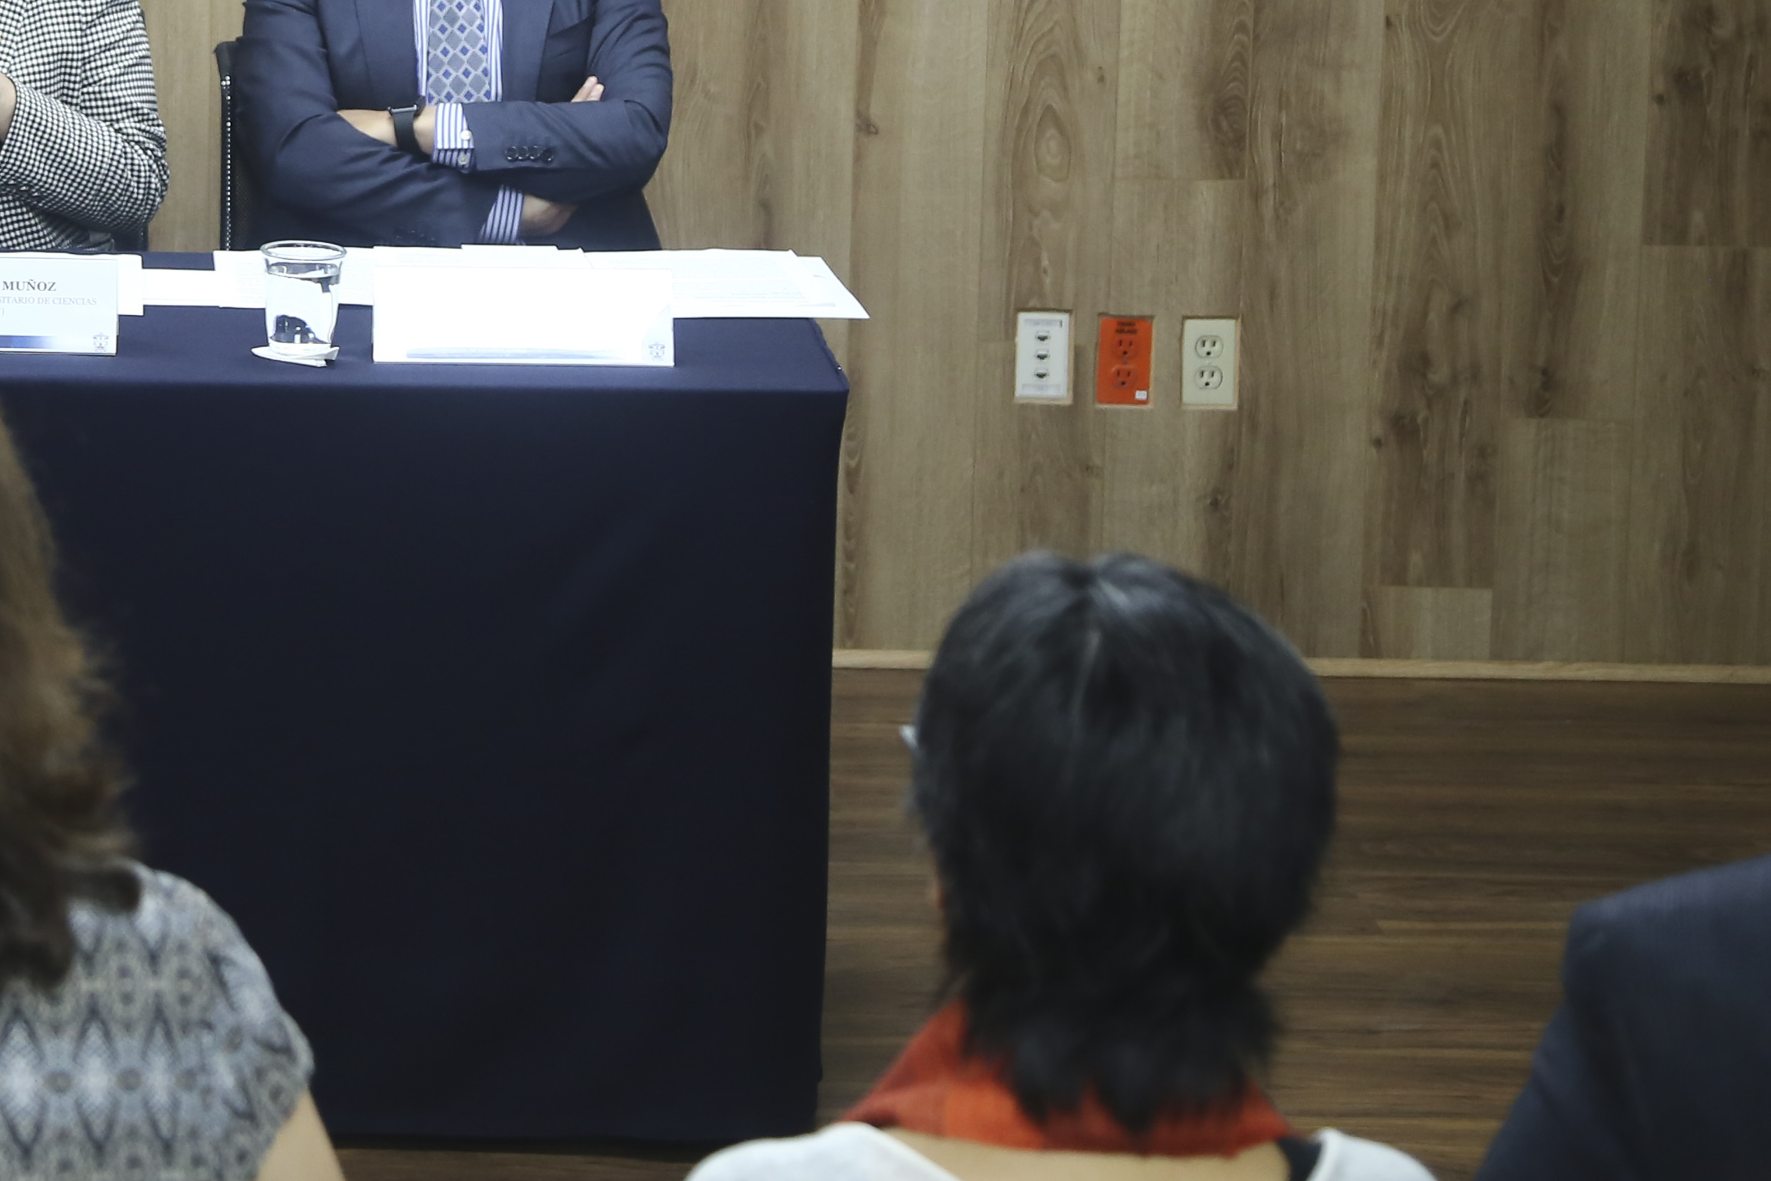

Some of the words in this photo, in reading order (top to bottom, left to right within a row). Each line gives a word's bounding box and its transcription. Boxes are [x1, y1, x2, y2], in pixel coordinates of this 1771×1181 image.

[2, 278, 57, 292] MUÑOZ
[37, 296, 51, 306] DE
[52, 296, 97, 307] CIENCIAS
